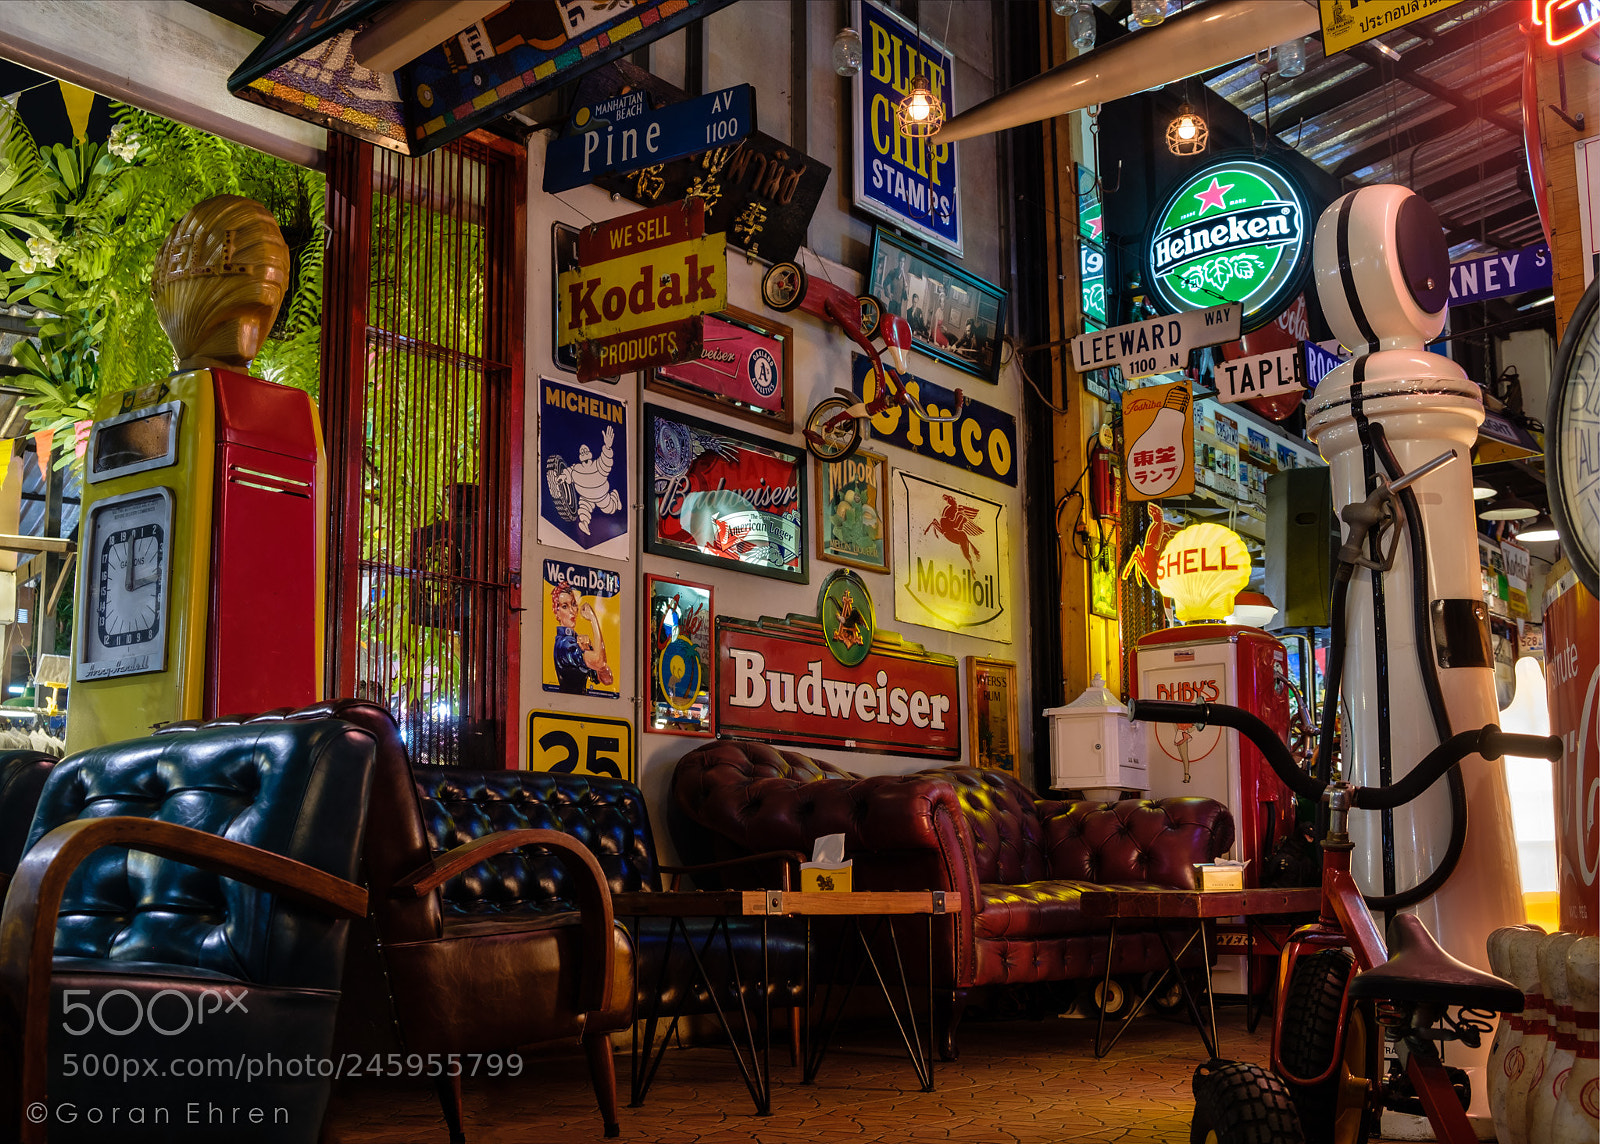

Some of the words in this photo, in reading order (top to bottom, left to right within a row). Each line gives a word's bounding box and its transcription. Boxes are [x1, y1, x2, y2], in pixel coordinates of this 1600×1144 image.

[869, 20, 945, 103] BLUE
[595, 92, 643, 117] MANHATTAN
[616, 107, 643, 121] BEACH
[712, 90, 734, 115] AV
[706, 117, 738, 144] 1100
[870, 93, 949, 186] CHIP
[582, 121, 661, 173] Pine
[872, 158, 950, 226] STAMPS
[609, 225, 633, 250] WE
[637, 215, 671, 243] SELL
[568, 253, 717, 331] Kodak
[1204, 308, 1230, 326] WAY
[600, 331, 677, 368] PRODUCTS
[1079, 320, 1182, 367] LEEWARD
[1129, 357, 1157, 375] 1100
[1170, 352, 1179, 367] N
[545, 386, 623, 424] MICHELIN
[1124, 398, 1162, 415] Toshiba
[1133, 446, 1176, 467] 東芝
[829, 459, 876, 502] MIDORI
[1134, 465, 1178, 485] ランプ
[655, 475, 797, 518] Budweiser
[120, 530, 126, 541] 19
[152, 524, 157, 534] 2
[727, 519, 767, 537] American
[769, 521, 794, 542] Lager
[120, 557, 145, 569] GAONS
[547, 562, 565, 583] We
[566, 567, 587, 588] Can
[588, 570, 604, 591] Do
[1157, 546, 1239, 580] SHELL
[917, 557, 994, 609] Mobiloil
[103, 635, 110, 645] 12
[125, 633, 132, 644] 10
[136, 632, 141, 642] 9
[148, 629, 153, 639] 8
[729, 647, 950, 730] Budweiser
